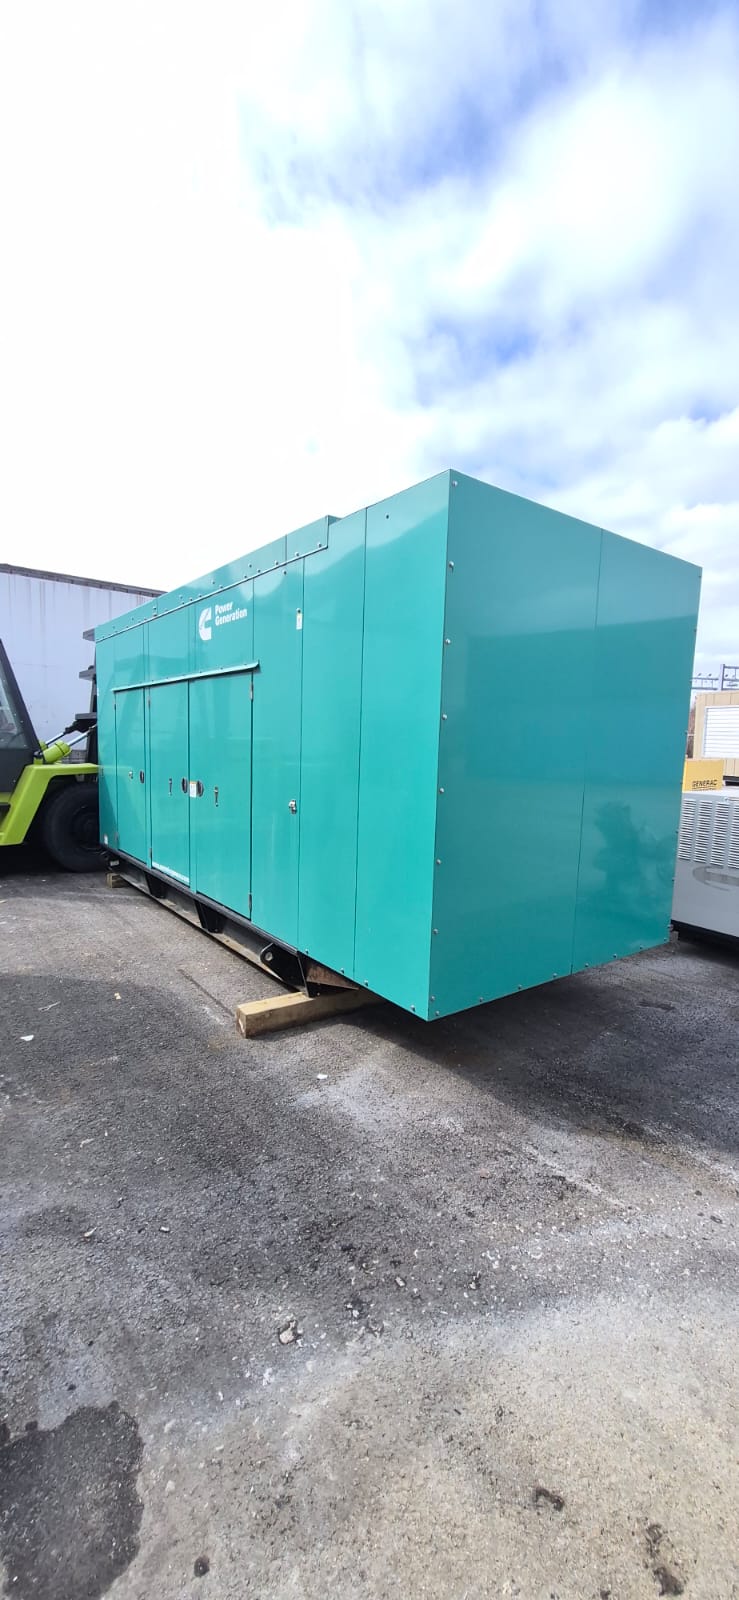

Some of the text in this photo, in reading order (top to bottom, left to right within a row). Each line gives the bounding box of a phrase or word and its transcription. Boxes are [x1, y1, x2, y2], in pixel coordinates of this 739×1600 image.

[215, 602, 233, 616] Power
[215, 608, 248, 626] Generation
[692, 779, 718, 787] GENERAC
